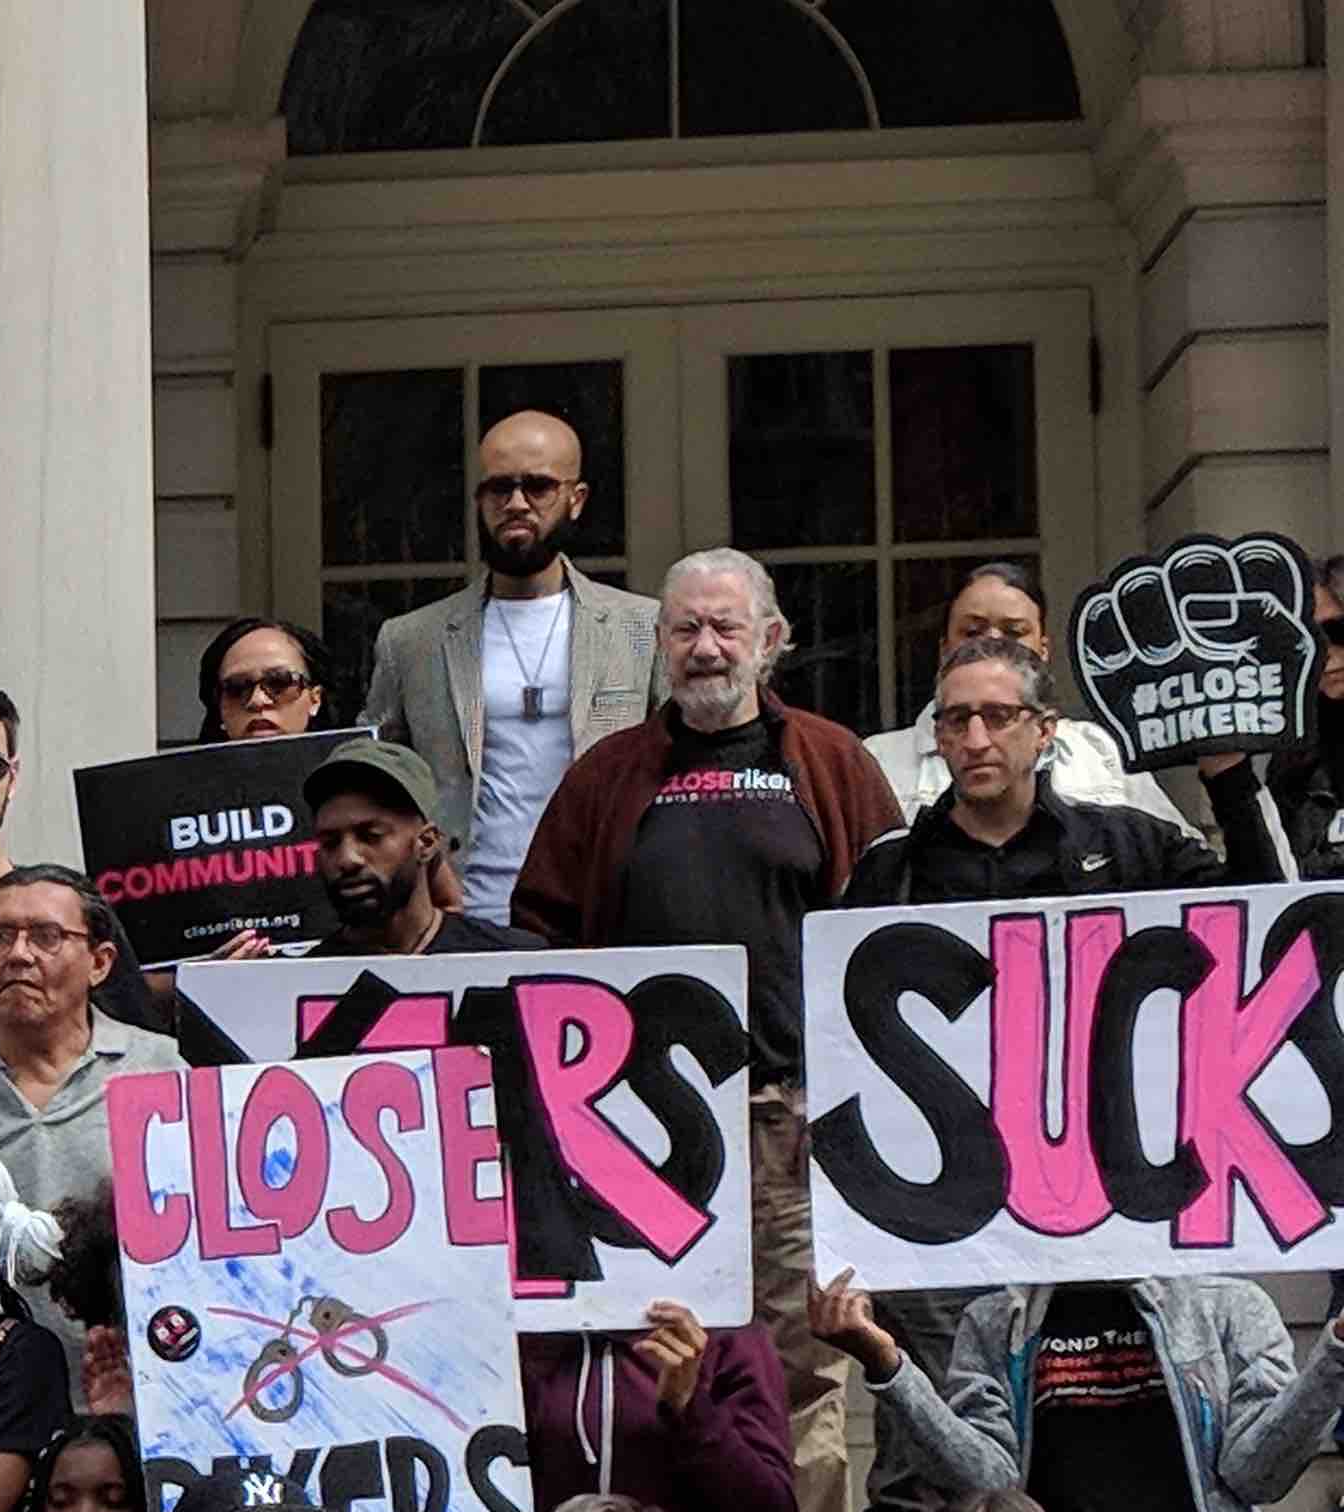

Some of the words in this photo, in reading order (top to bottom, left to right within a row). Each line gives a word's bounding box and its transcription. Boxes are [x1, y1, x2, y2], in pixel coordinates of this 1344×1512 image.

[1130, 662, 1285, 711] #CLOSE
[1138, 700, 1287, 750] RIKERS
[169, 804, 294, 851] BUILD
[106, 1045, 510, 1266] CLOSE
